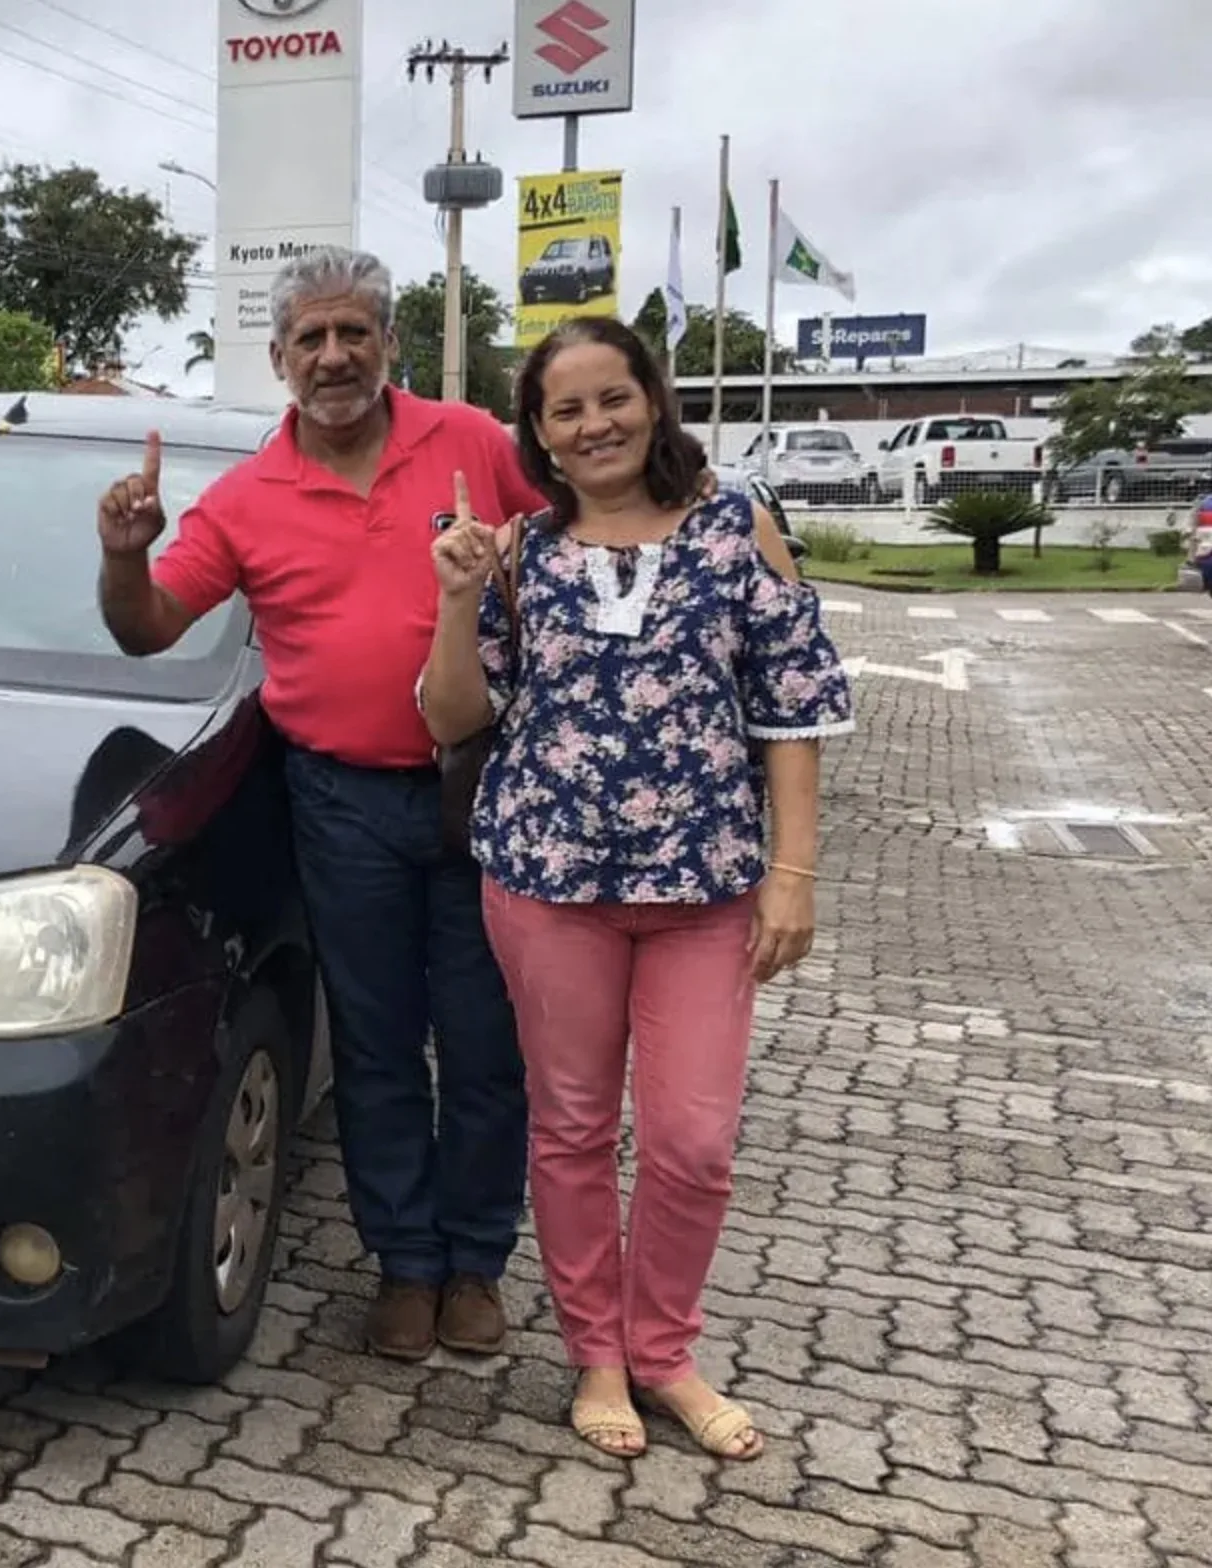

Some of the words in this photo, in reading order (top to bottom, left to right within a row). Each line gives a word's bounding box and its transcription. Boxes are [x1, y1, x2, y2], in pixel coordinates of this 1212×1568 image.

[225, 30, 341, 62] TOYOTA
[532, 79, 609, 97] SUZUKI
[524, 183, 567, 220] 4x4
[230, 244, 274, 264] Kyoto
